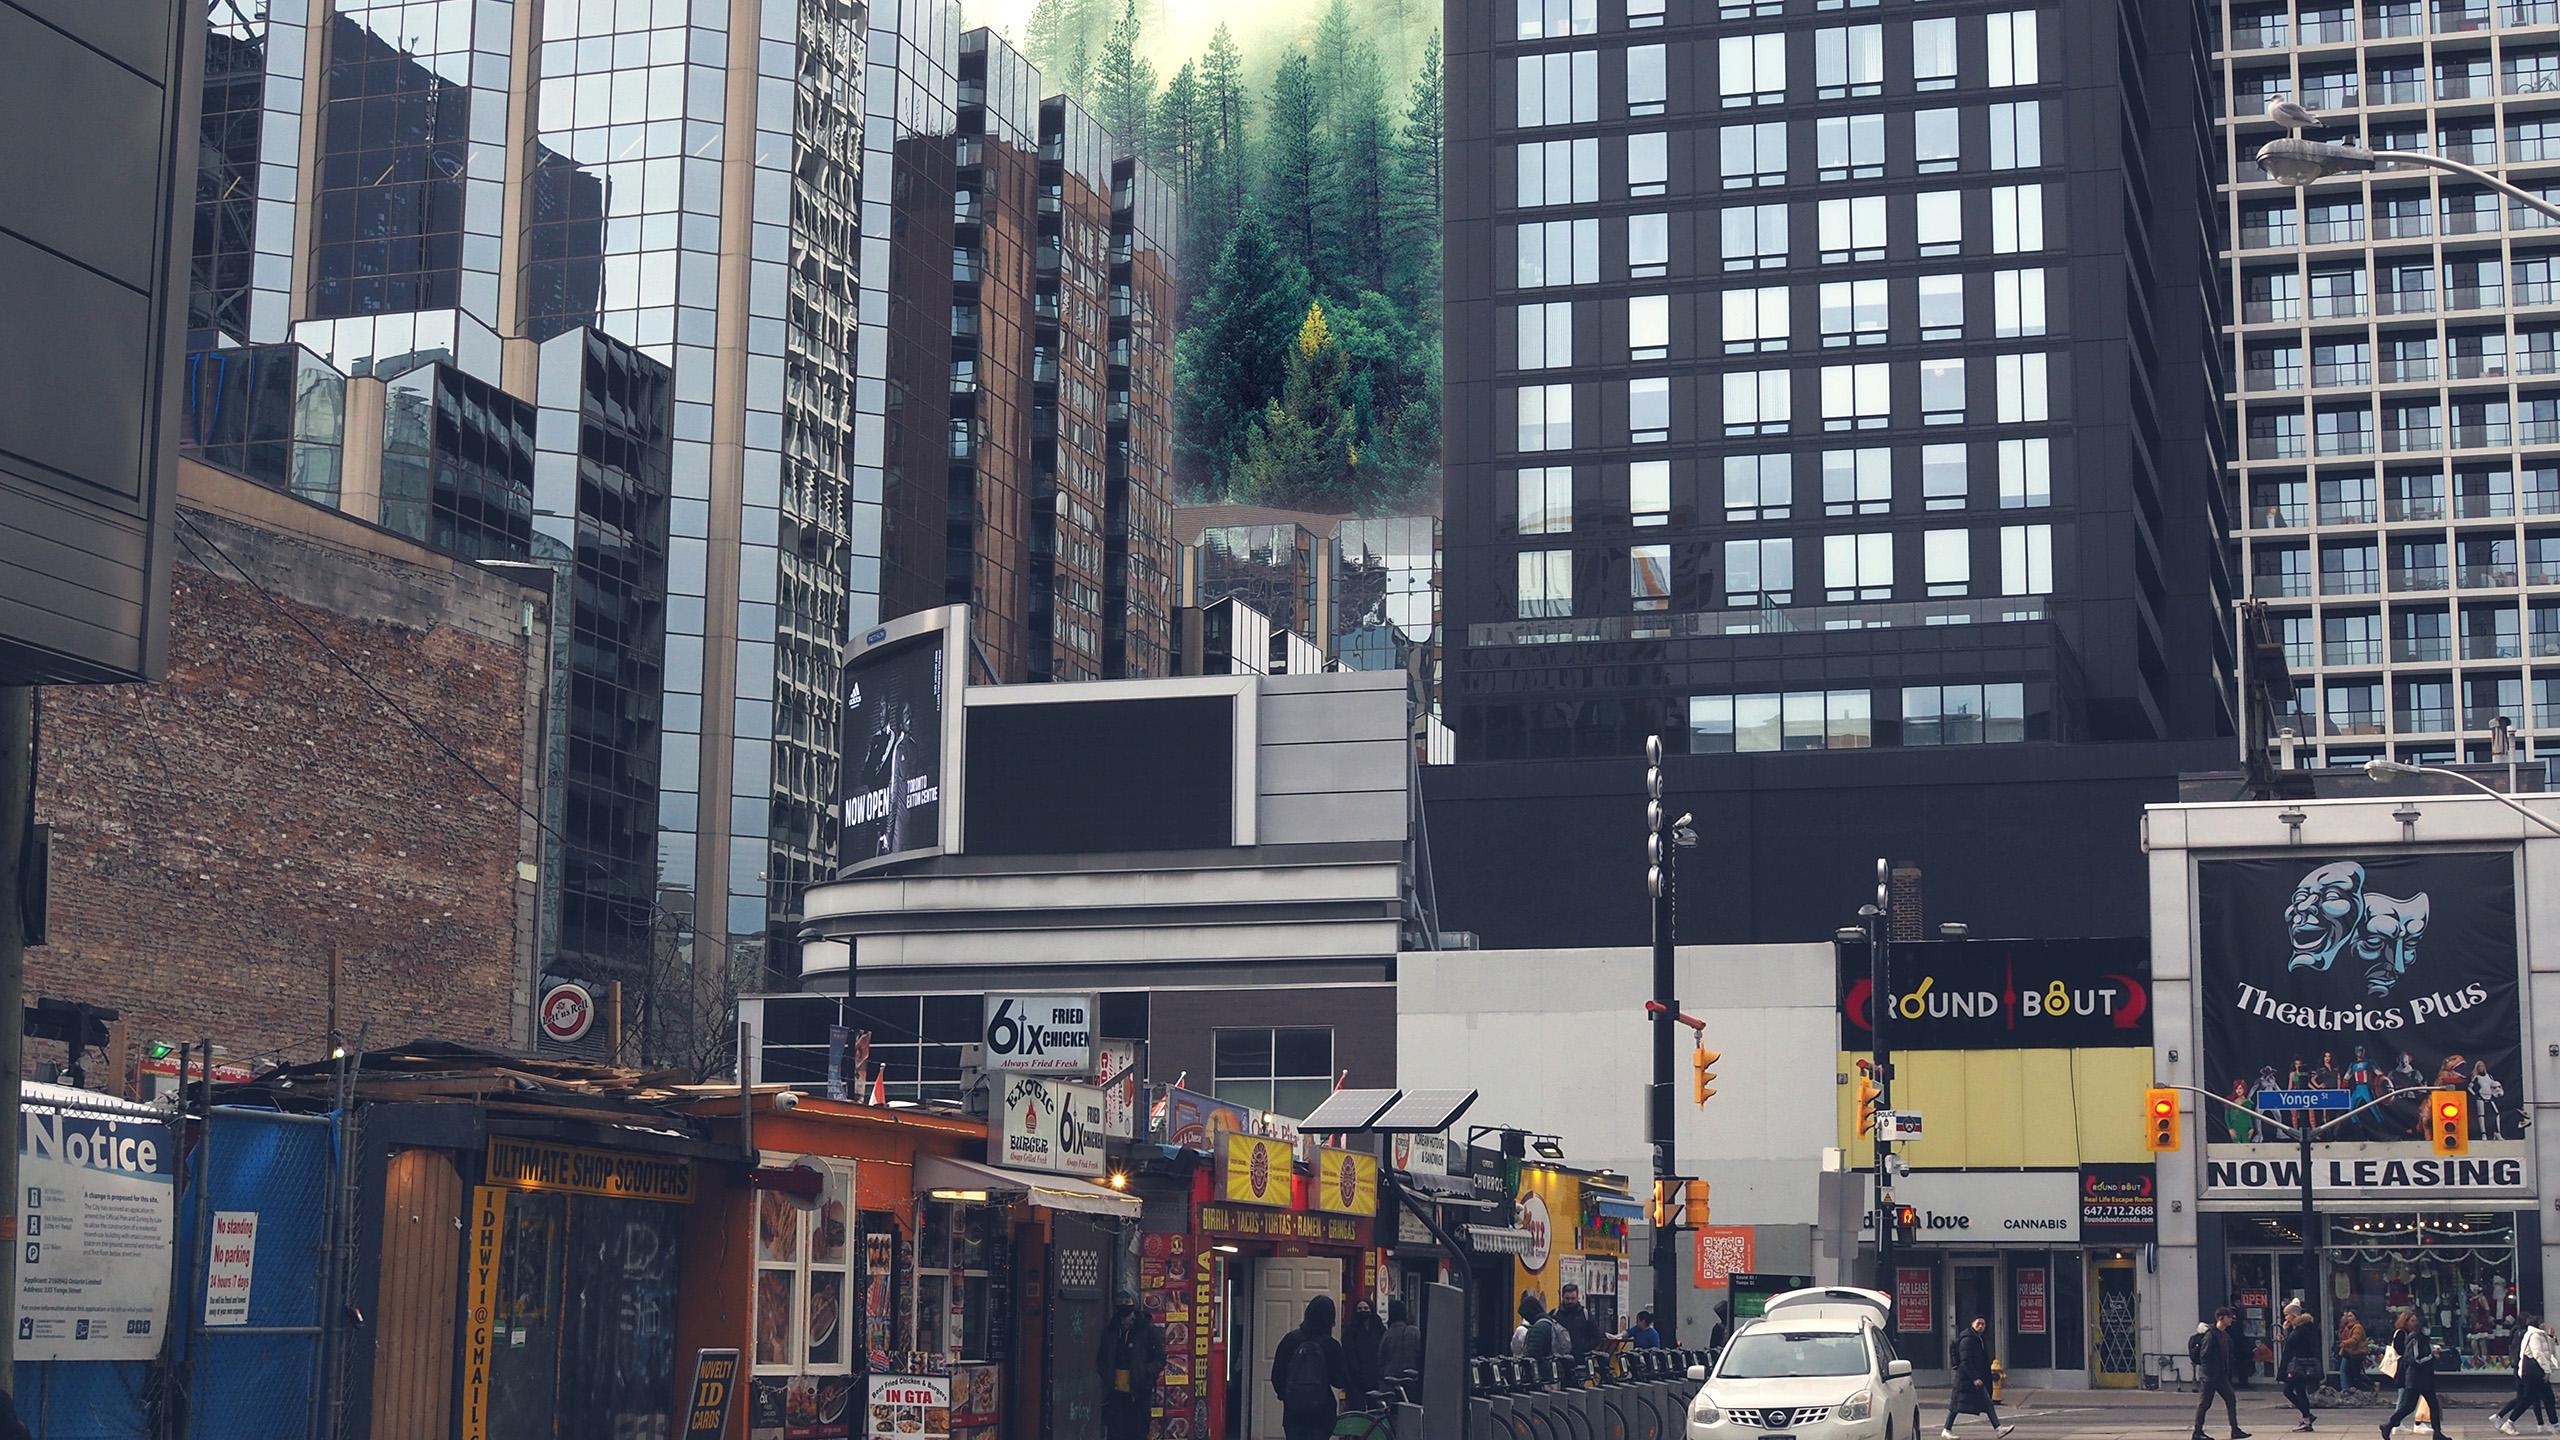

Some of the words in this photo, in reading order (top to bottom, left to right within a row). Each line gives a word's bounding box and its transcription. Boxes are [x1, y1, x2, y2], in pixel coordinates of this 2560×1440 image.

[907, 775, 928, 794] TORONTO
[845, 794, 866, 828] NOW
[866, 786, 890, 822] OPEN
[2023, 980, 2117, 1017] BOUT
[2236, 981, 2404, 1031] Theatrics
[2410, 982, 2488, 1025] Plus
[1052, 1008, 1084, 1024] FRIED
[1042, 1031, 1090, 1048] CHICKEN
[1001, 1059, 1029, 1070] Always
[1031, 1059, 1054, 1068] Fried
[1055, 1059, 1078, 1068] Fresh
[1006, 1079, 1054, 1115] EXOTIC
[2280, 1092, 2318, 1108] Yonge
[2321, 1092, 2328, 1100] St
[1087, 1106, 1100, 1124] FRIED
[1878, 1110, 1896, 1118] POLICE
[26, 1111, 157, 1173] Notice
[1010, 1135, 1048, 1154] BURGER
[1084, 1130, 1104, 1149] CHICKEN
[492, 1143, 569, 1184] ULTIMATE
[573, 1152, 614, 1190] SHOP
[614, 1158, 688, 1196] SCOOTERS
[2208, 1161, 2312, 1187] NOW
[2330, 1159, 2521, 1186] LEASING
[1473, 1173, 1503, 1192] CHURROS
[2092, 1181, 2118, 1190] ROUND
[2121, 1182, 2141, 1190] BOUT
[2112, 1196, 2134, 1204] Escape
[1926, 1211, 1970, 1229] love
[2084, 1206, 2154, 1216] 647.712.2688
[216, 1218, 226, 1234] No
[227, 1218, 253, 1238] standing
[1203, 1208, 1229, 1231] BIRRIA
[1237, 1210, 1260, 1234] TACOS
[1264, 1213, 1292, 1236] TORTAS
[1298, 1216, 1322, 1237] RAMEN
[2003, 1219, 2068, 1230] CANNABIS
[214, 1244, 224, 1262] No
[224, 1244, 250, 1268] parking
[210, 1274, 216, 1288] 24
[218, 1274, 232, 1288] hours
[238, 1274, 250, 1291] days
[1900, 1282, 1910, 1294] FOR
[1911, 1282, 1928, 1294] LEASE
[2030, 1283, 2043, 1295] LEASE
[2242, 1294, 2268, 1306] OPEN
[700, 1360, 734, 1380] NOVELTY
[698, 1382, 724, 1408] ID
[872, 1384, 884, 1399] Best
[884, 1380, 898, 1389] Fried
[900, 1377, 920, 1386] Chicken
[928, 1381, 948, 1402] Burgers
[886, 1390, 900, 1403] IN
[904, 1390, 932, 1404] GTA
[692, 1410, 721, 1430] CARDS
